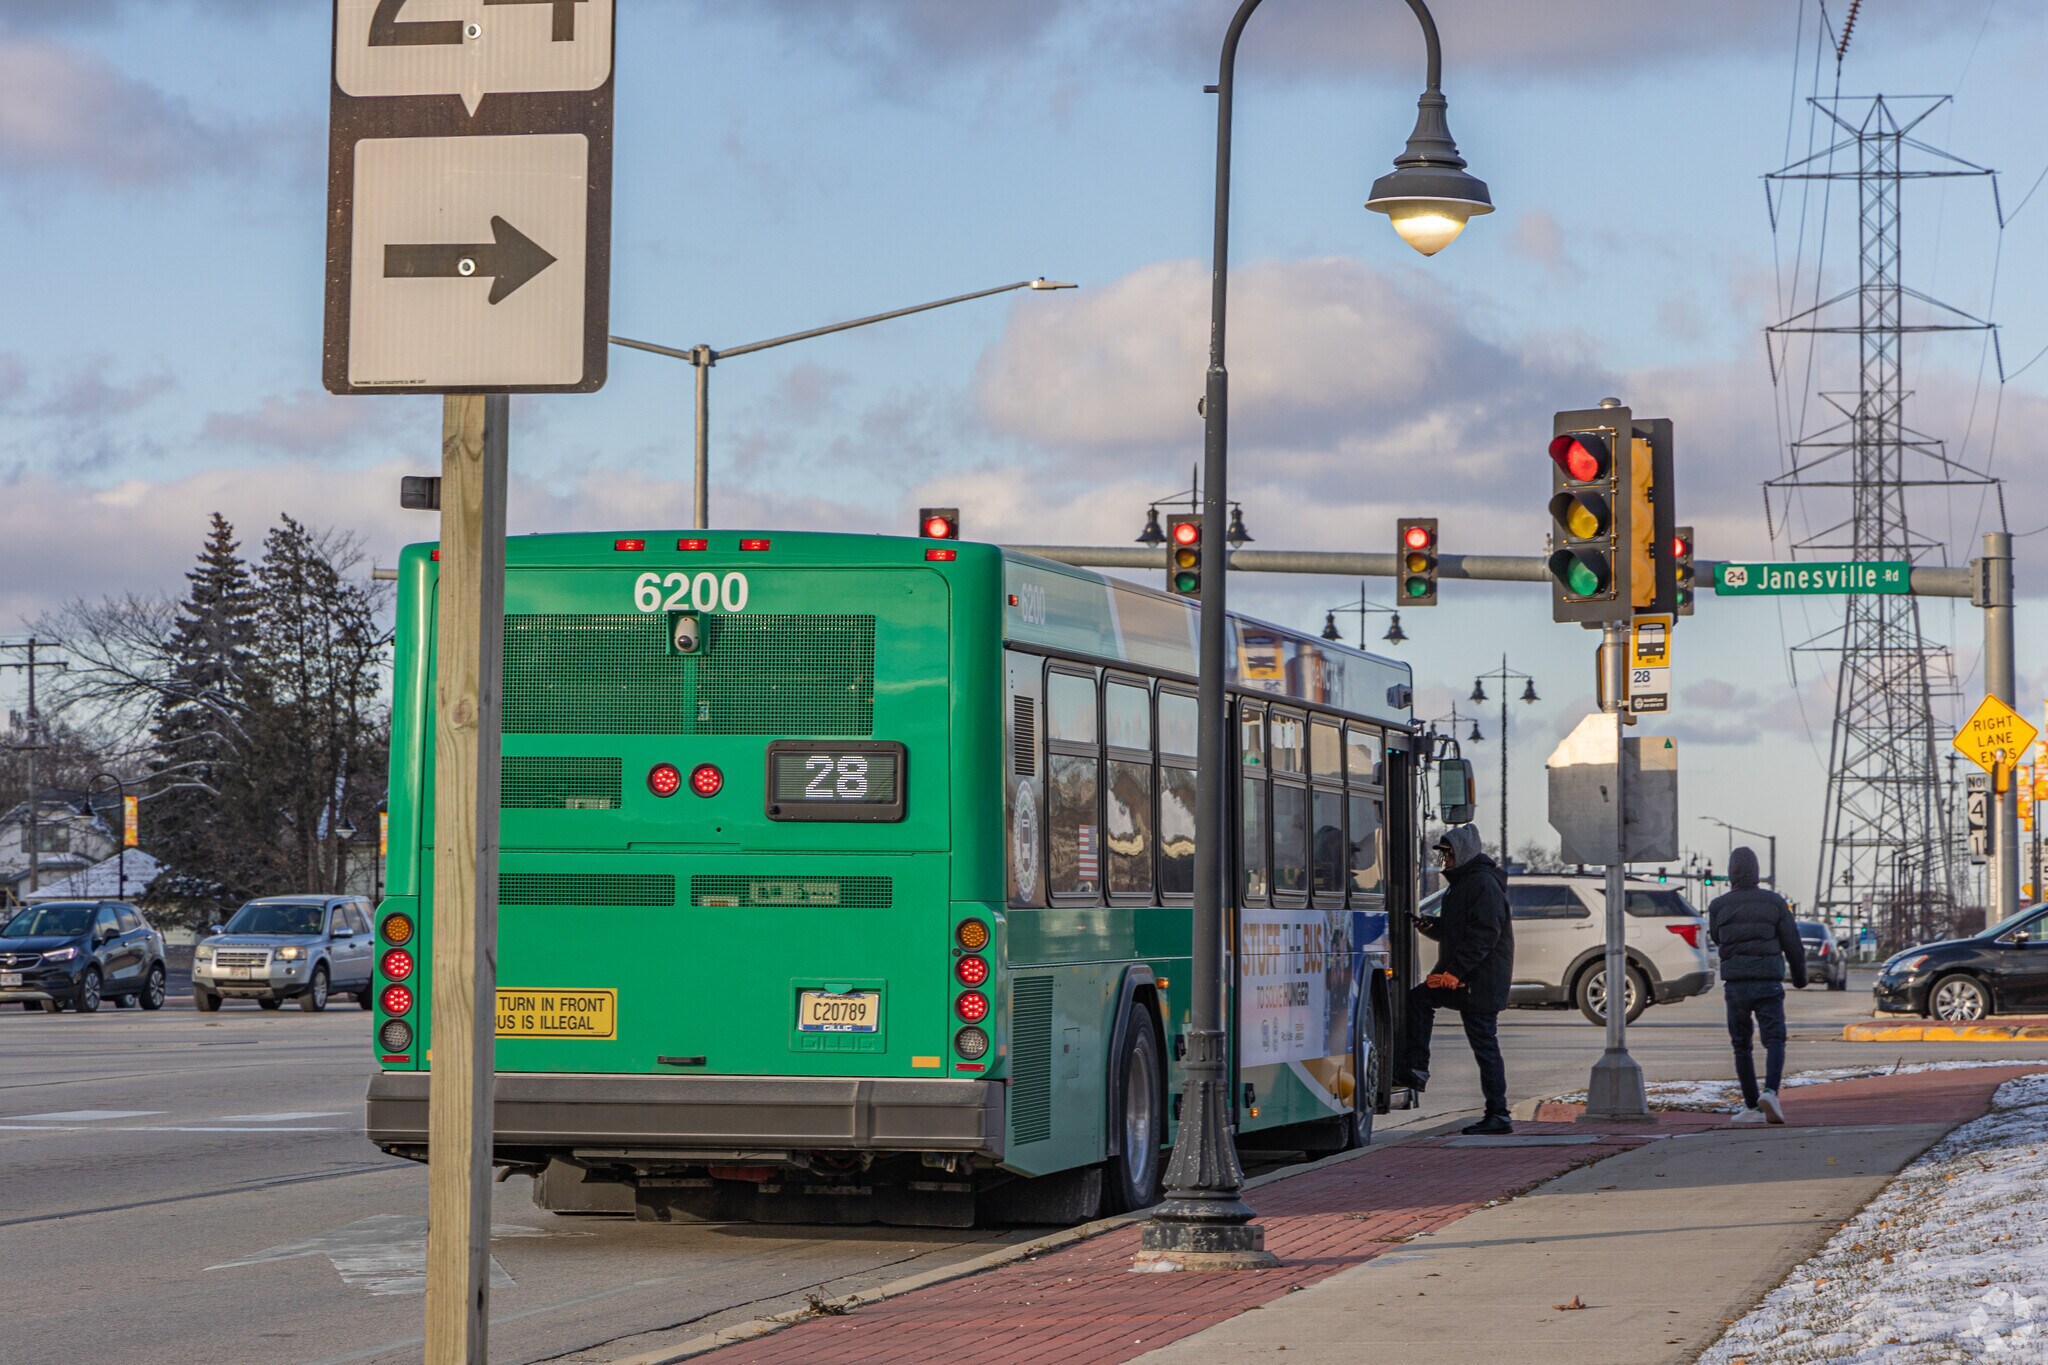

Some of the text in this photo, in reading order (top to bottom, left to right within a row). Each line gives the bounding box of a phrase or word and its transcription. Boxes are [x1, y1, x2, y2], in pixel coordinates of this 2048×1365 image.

[1727, 565, 1899, 590] 24 Janesville Rd
[634, 571, 749, 613] 6200
[1022, 582, 1046, 625] 6200
[1633, 670, 1651, 683] 28
[1973, 715, 2013, 732] RIGHT
[1977, 732, 2014, 748] LANE
[805, 755, 868, 798] 28
[1242, 922, 1323, 977] STUFF THE BUS
[499, 996, 606, 1012] TURN IN FRONT
[813, 1002, 867, 1021] C20789
[494, 1014, 595, 1030] US IS ILLEGAL
